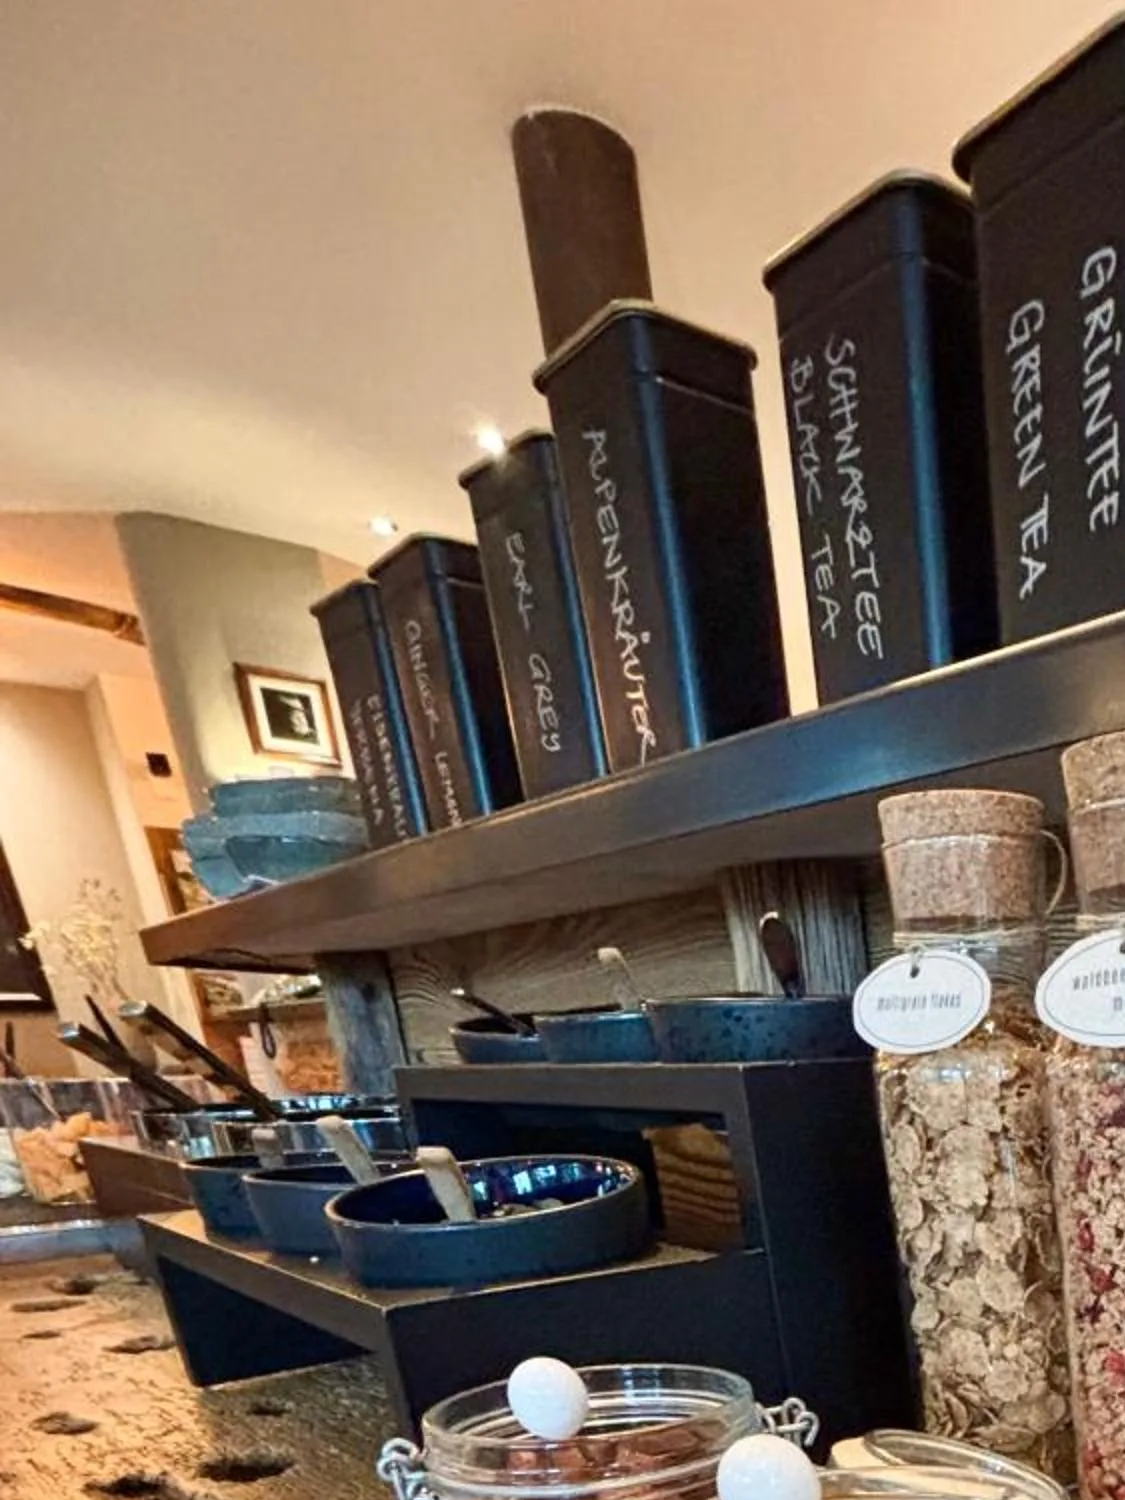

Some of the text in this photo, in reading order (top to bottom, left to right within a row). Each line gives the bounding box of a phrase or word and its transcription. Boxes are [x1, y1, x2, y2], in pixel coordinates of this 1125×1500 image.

[791, 355, 841, 640] BLACK TEA
[1005, 298, 1049, 600] GREEN TEA
[1080, 246, 1123, 533] GRÜNTEE
[506, 532, 562, 754] EARL GREY
